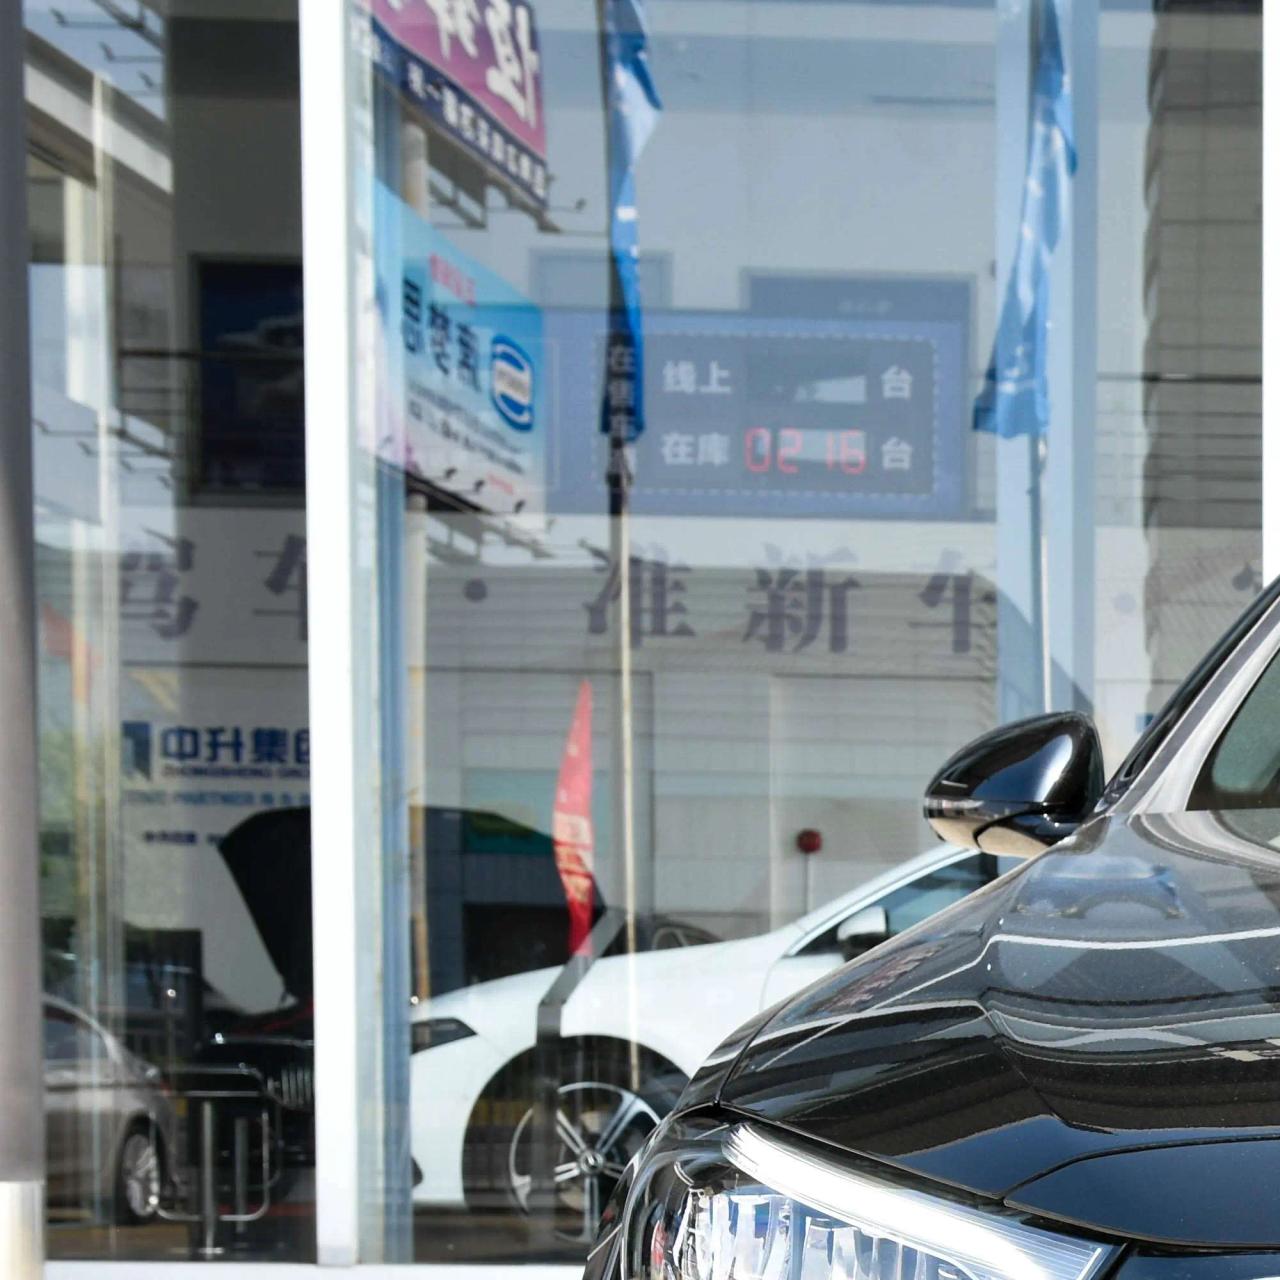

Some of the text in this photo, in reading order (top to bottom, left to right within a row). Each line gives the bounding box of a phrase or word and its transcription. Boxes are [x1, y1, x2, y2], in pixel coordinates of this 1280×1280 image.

[661, 360, 914, 400] 线上 台
[660, 426, 914, 475] 在库 0216 台
